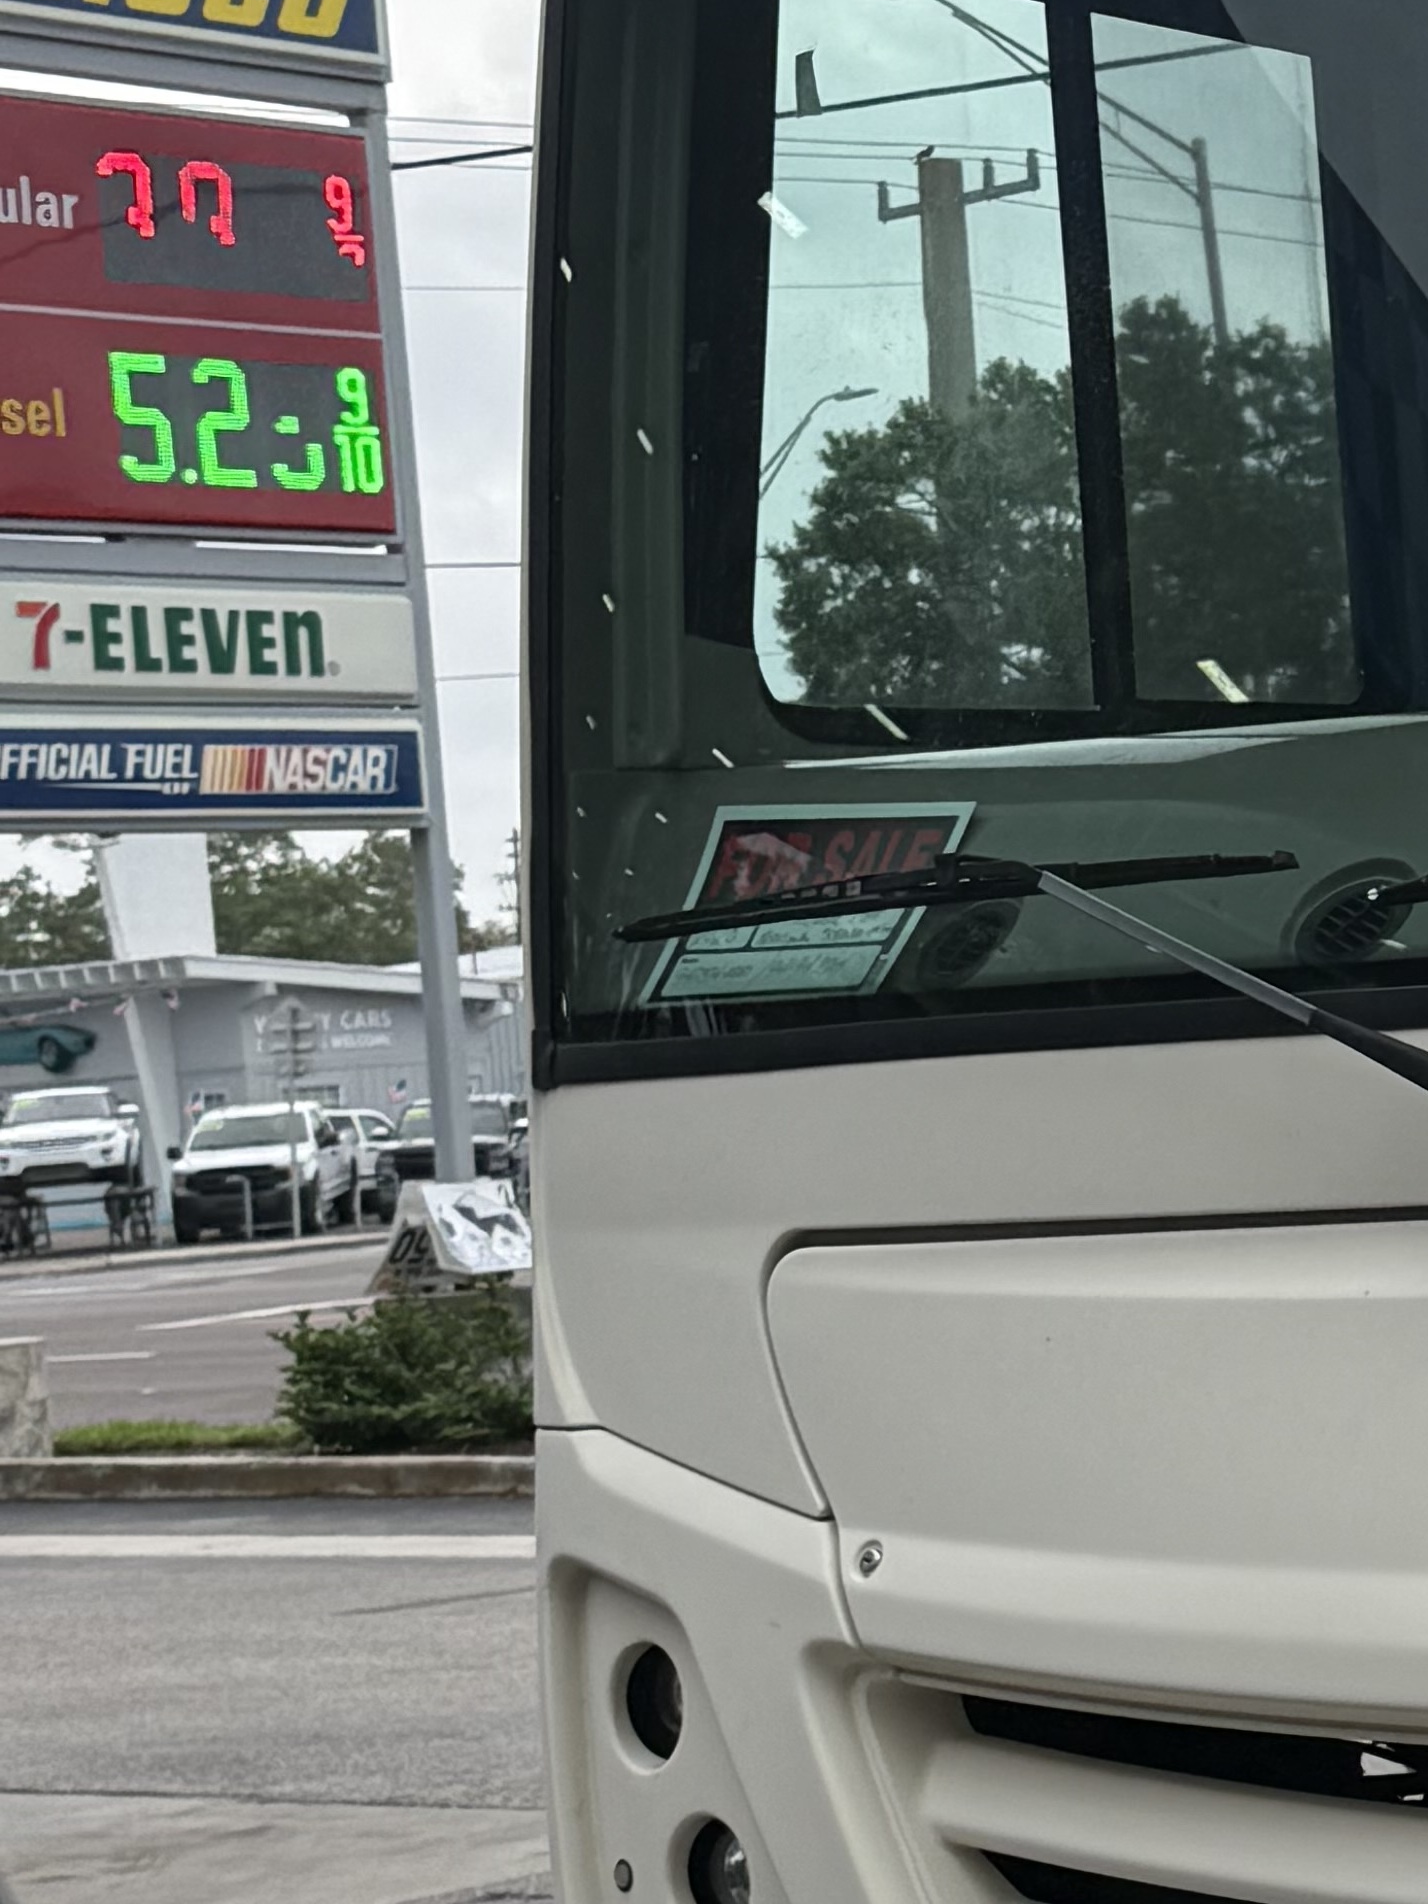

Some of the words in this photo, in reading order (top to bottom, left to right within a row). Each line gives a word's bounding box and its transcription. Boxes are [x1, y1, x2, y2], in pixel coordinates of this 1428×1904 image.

[0, 742, 118, 781] FFICIAL
[121, 742, 199, 780] FUEL
[263, 746, 388, 793] NASCAR
